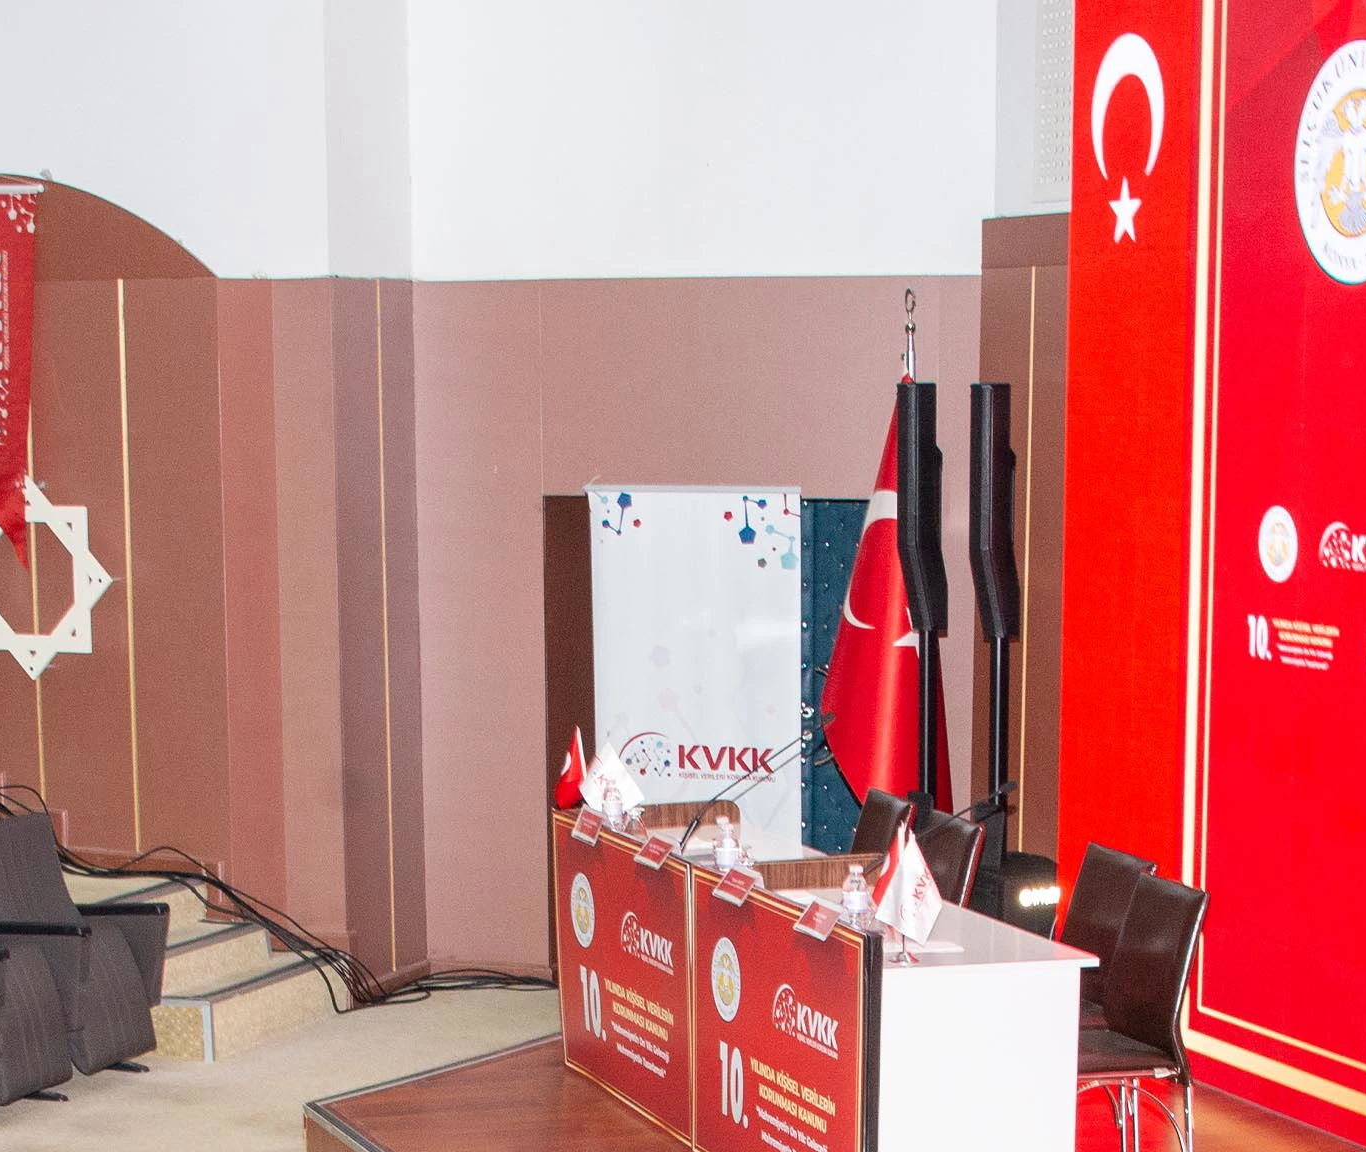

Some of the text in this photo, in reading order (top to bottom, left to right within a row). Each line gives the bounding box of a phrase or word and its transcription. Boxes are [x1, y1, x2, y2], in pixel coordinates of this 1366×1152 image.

[1247, 614, 1272, 661] 10.
[678, 744, 775, 775] KVKK
[640, 927, 674, 969] KVKK
[579, 963, 608, 1043] 10.
[796, 1001, 839, 1051] KVKK
[719, 1040, 750, 1130] 10.
